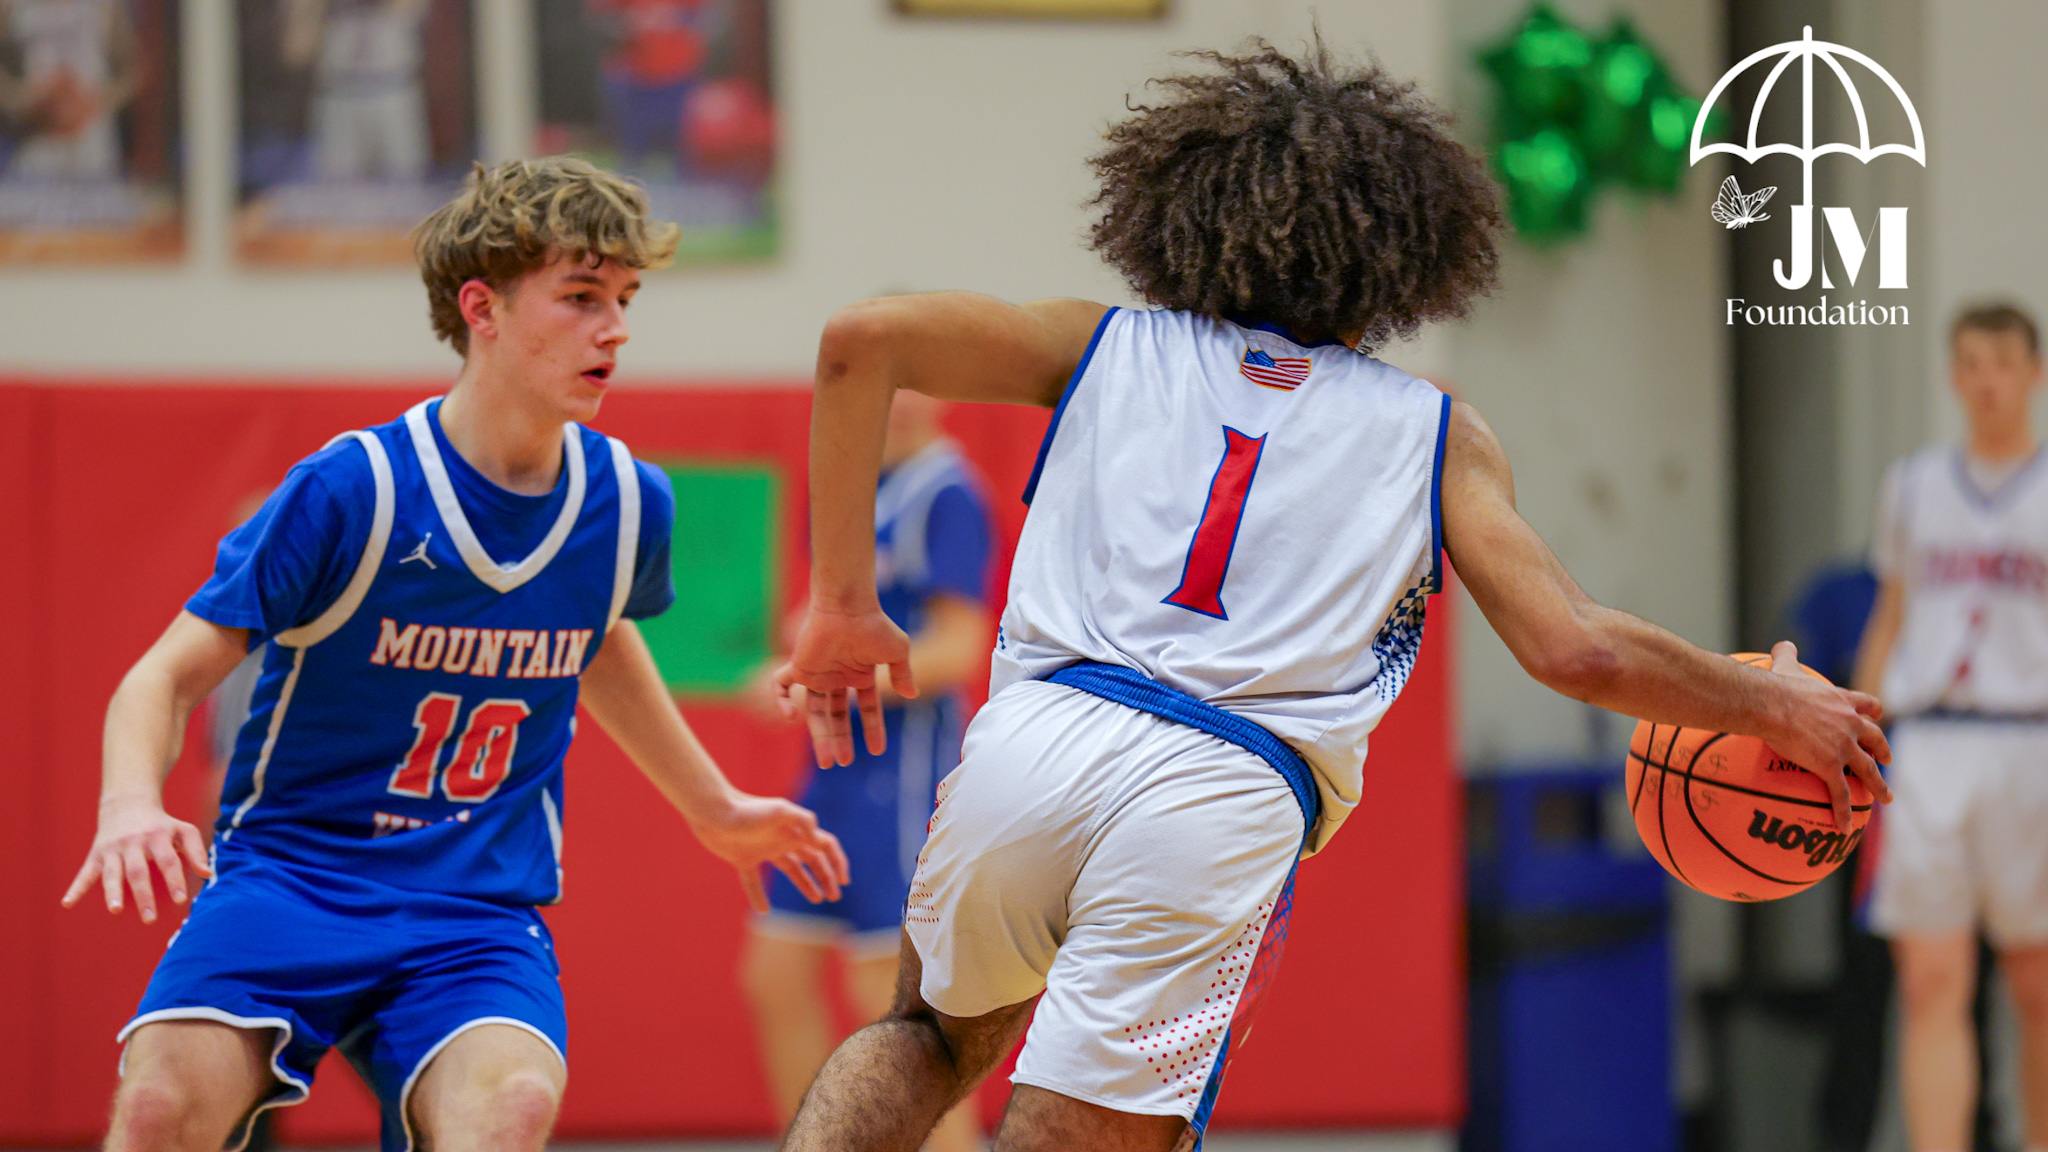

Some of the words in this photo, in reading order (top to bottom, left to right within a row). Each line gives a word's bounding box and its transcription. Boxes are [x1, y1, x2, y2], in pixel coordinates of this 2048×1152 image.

[1159, 424, 1269, 621] 1
[369, 617, 594, 679] MOUNTAIN
[386, 690, 532, 804] 10
